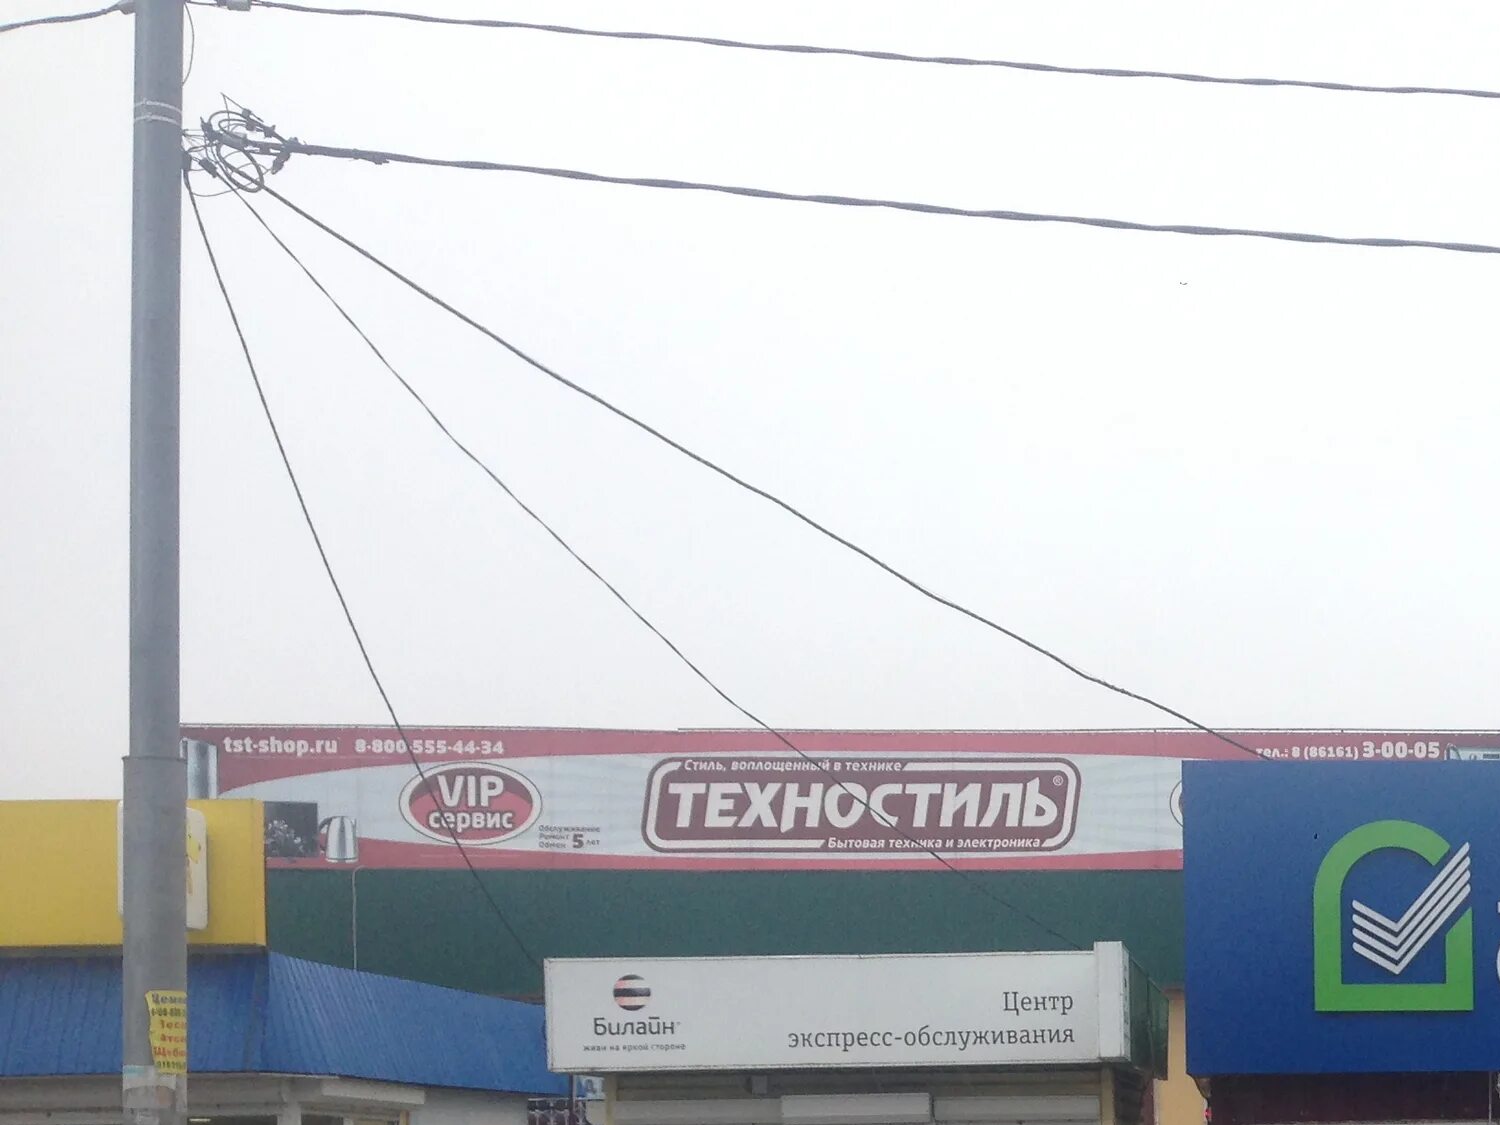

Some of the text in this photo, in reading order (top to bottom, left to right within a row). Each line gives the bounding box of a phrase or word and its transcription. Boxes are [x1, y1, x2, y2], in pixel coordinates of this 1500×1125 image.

[223, 735, 338, 757] tst-shop.ru
[1291, 746, 1300, 758] 8
[1362, 741, 1440, 759] 3-00-05
[684, 759, 902, 773] Стиль, воплощенный в технике
[436, 774, 505, 807] VIP
[668, 777, 1060, 834] ТЕХНОСТИЛЬ
[429, 810, 514, 832] сервис
[572, 833, 585, 849] 5
[828, 837, 1041, 849] Бытовая техника и электроника
[1003, 991, 1074, 1016] Центр
[594, 1017, 676, 1036] Билайн
[788, 1025, 1075, 1052] экспресс-обслуживания
